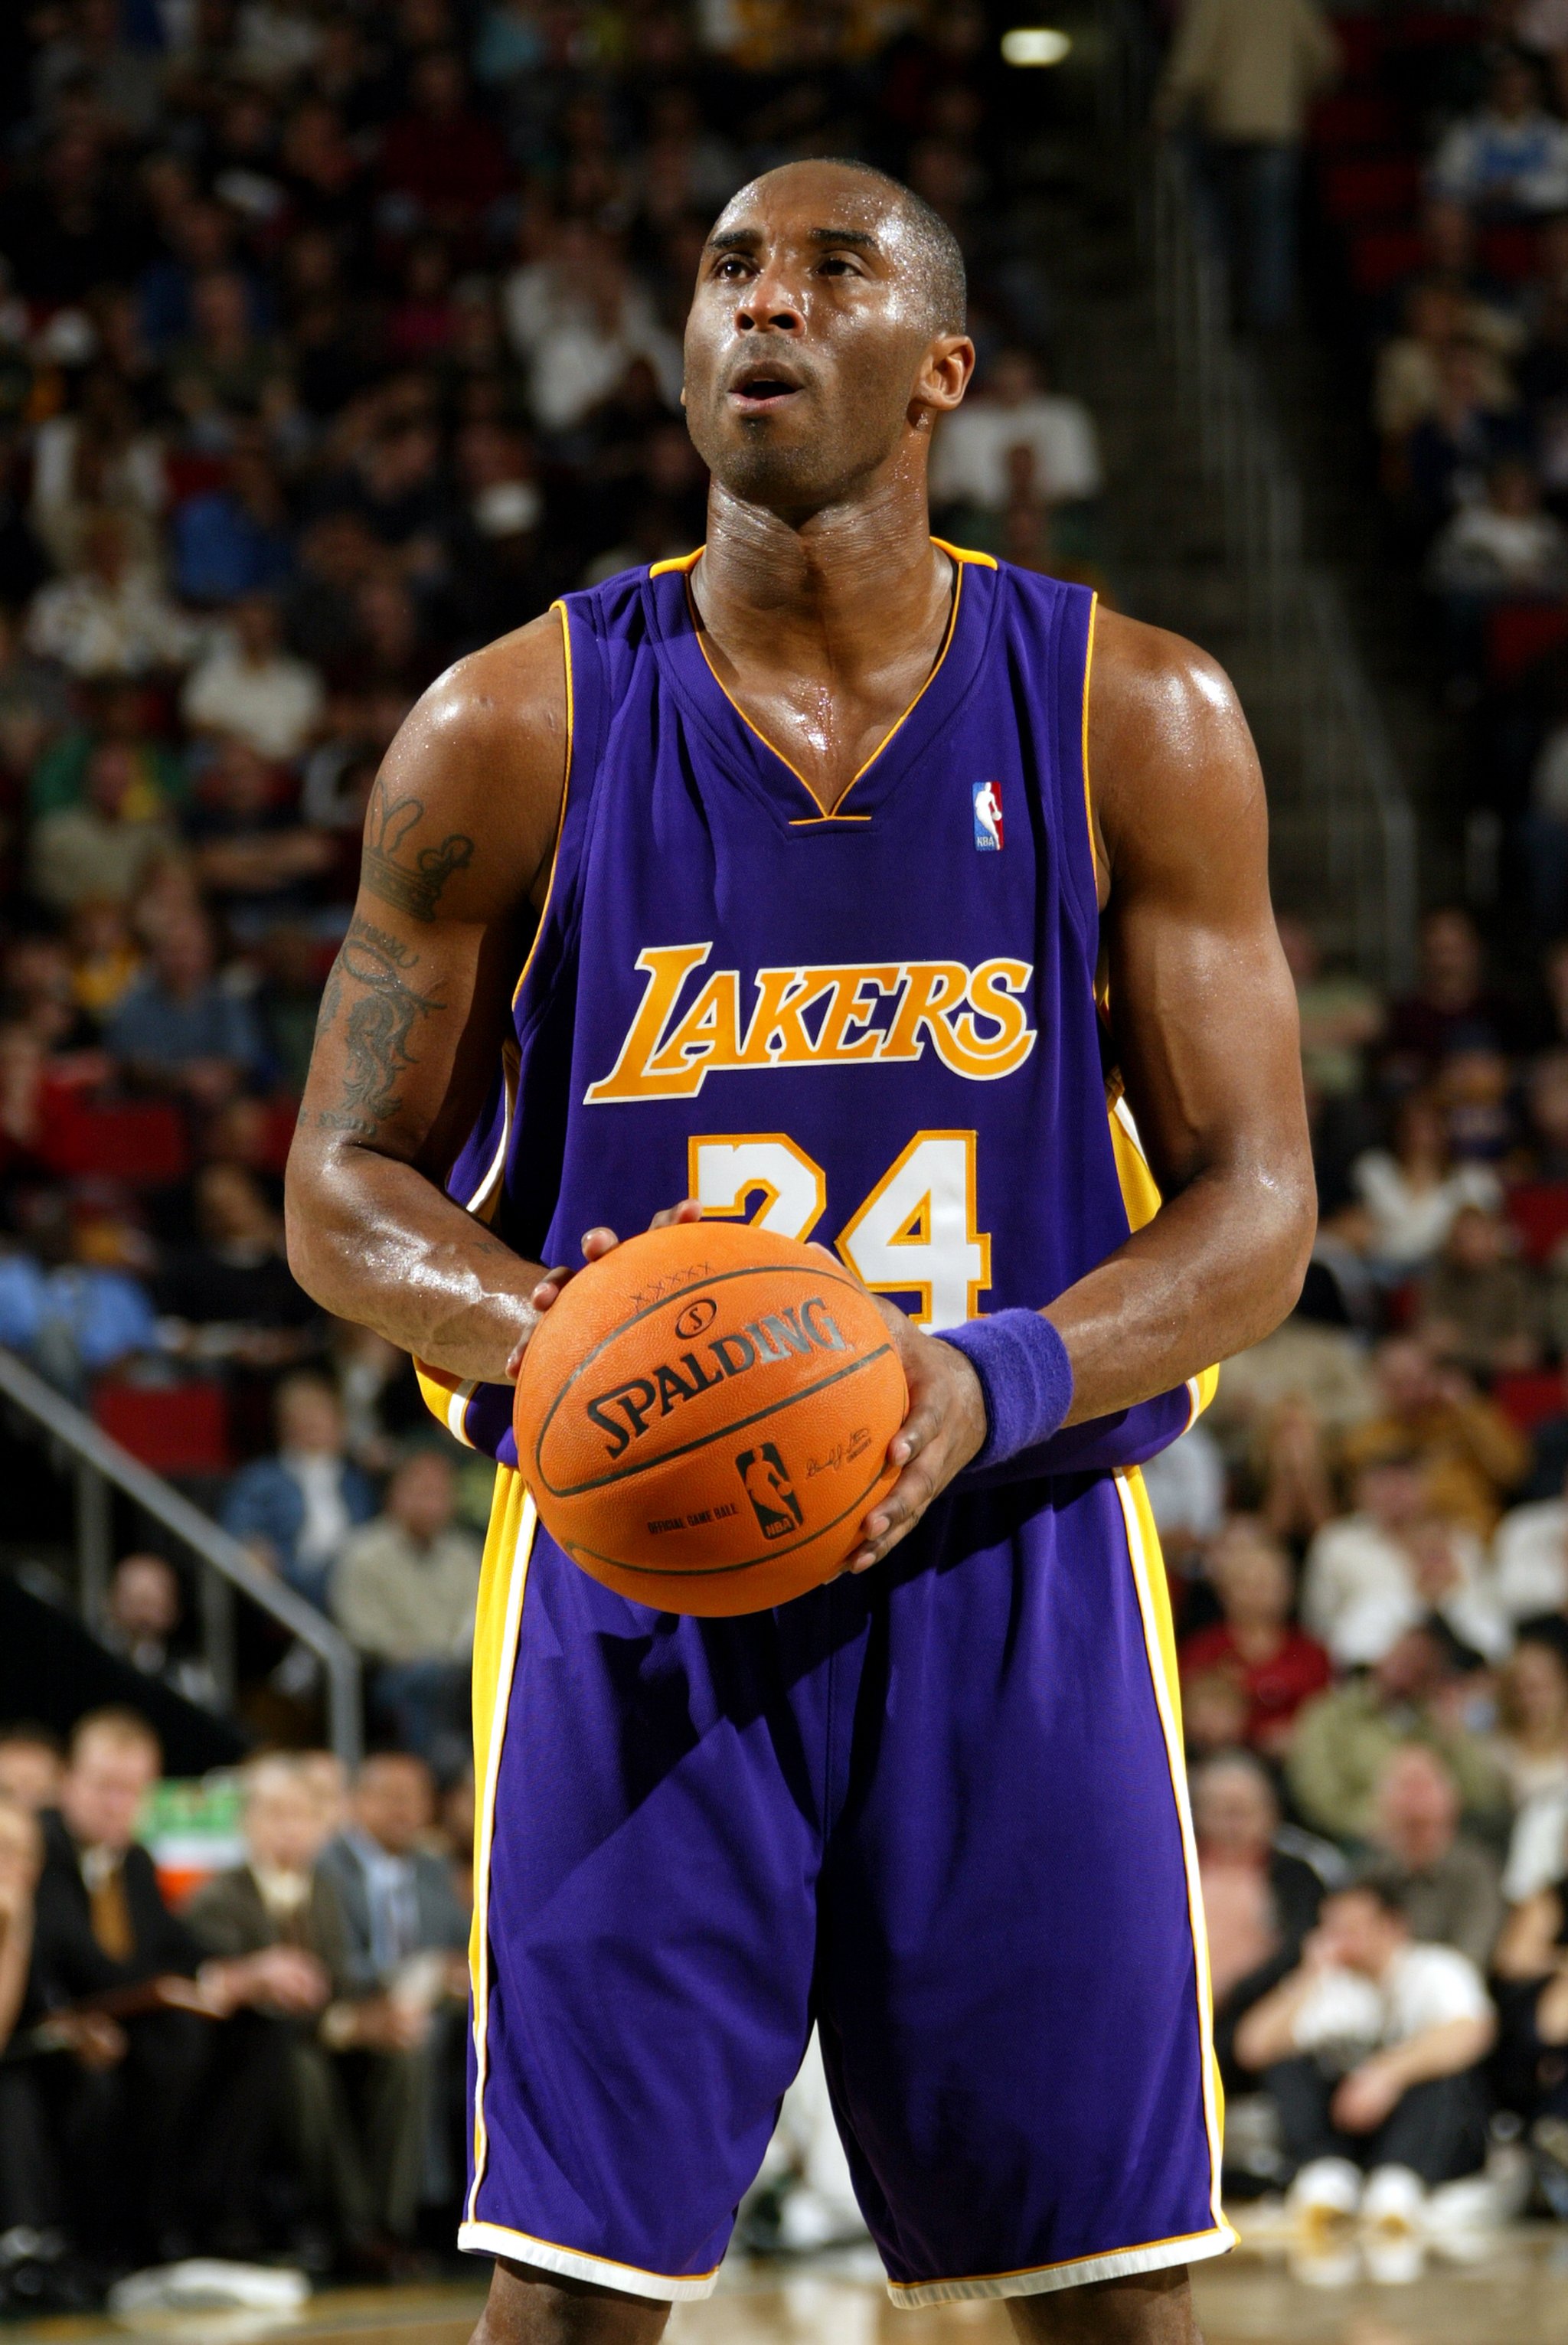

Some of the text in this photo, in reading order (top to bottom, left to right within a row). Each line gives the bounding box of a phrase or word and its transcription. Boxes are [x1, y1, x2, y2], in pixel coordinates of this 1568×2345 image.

[976, 836, 995, 847] NBA
[583, 941, 1037, 1106] LAKERS
[688, 1130, 992, 1334] 24
[586, 1296, 847, 1461] SPALDING
[647, 1503, 739, 1534] OFFICIAL GAME BALL
[766, 1518, 792, 1537] NBA
